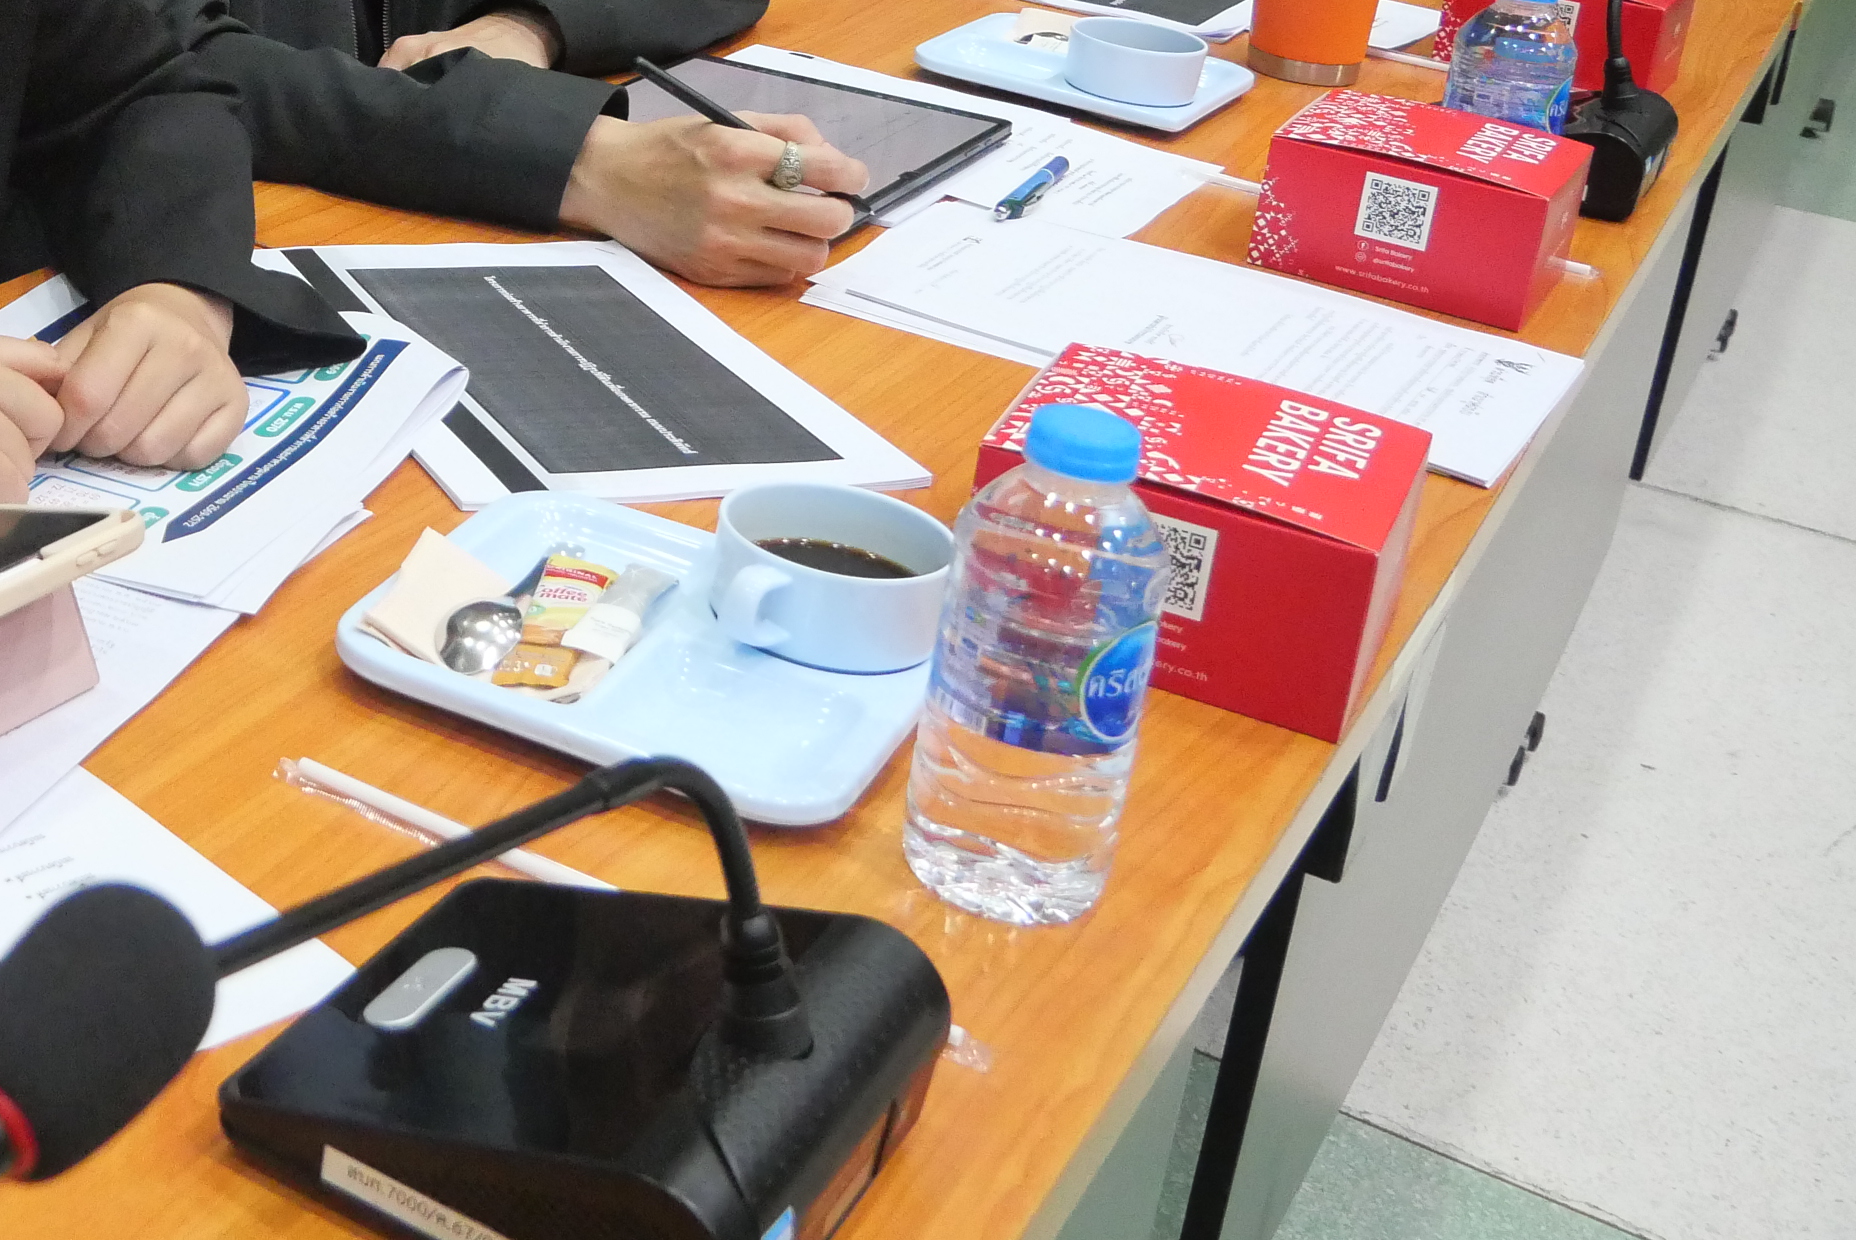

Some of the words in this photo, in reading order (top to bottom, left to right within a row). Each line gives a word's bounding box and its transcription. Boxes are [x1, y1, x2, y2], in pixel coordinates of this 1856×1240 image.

[1455, 122, 1520, 164] BAKERY
[1502, 133, 1557, 165] SRIFA
[1390, 249, 1414, 261] Bakery
[1334, 265, 1430, 294] www.srifabakery.co.th
[265, 416, 289, 433] 2570
[1241, 399, 1330, 488] BAKERY
[1307, 416, 1384, 481] SRIFA
[188, 473, 212, 487] 2571
[538, 592, 588, 603] mate
[468, 976, 540, 1029] MBV
